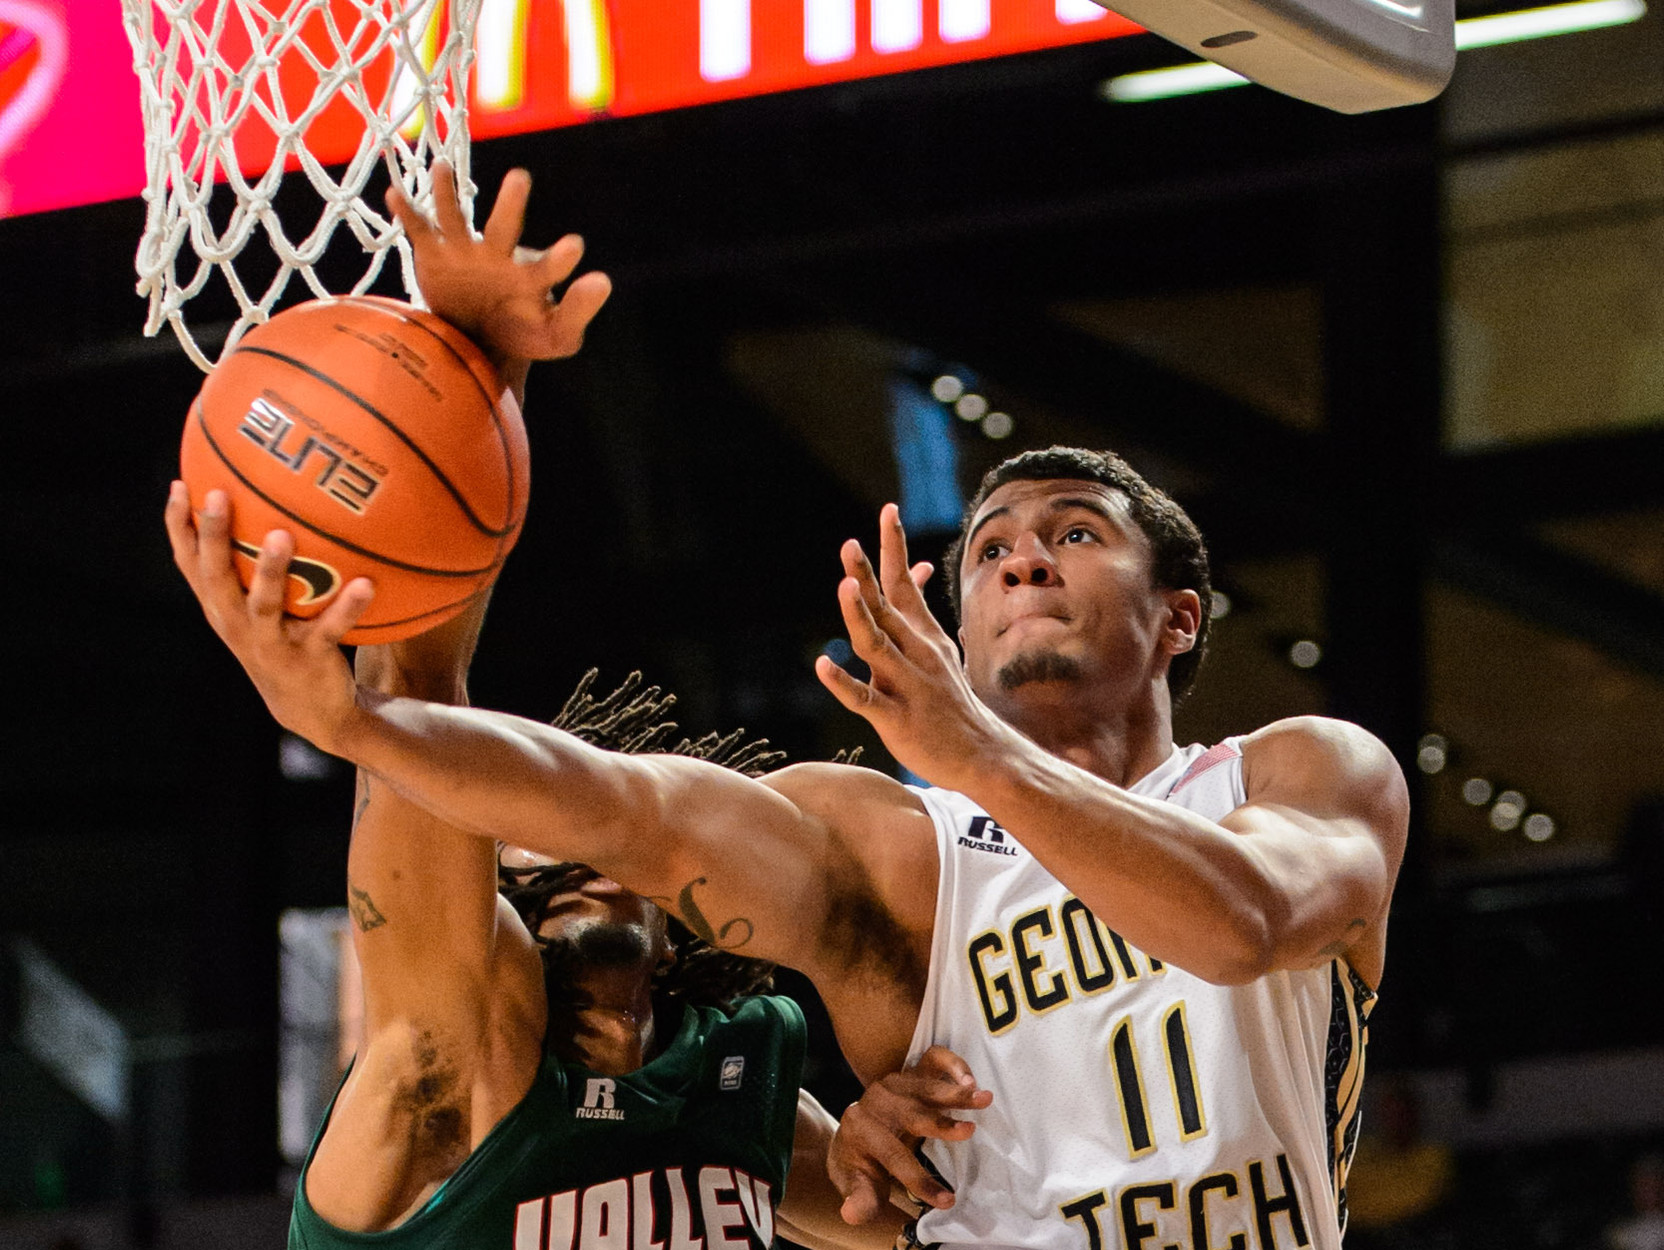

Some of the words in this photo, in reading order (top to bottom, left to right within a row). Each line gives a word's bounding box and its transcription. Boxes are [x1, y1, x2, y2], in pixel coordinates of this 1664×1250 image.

[237, 397, 381, 516] ELITE
[958, 836, 1018, 857] RUSSELL
[584, 1078, 616, 1109] R
[1110, 999, 1207, 1161] 11
[576, 1107, 625, 1121] RUSSELL
